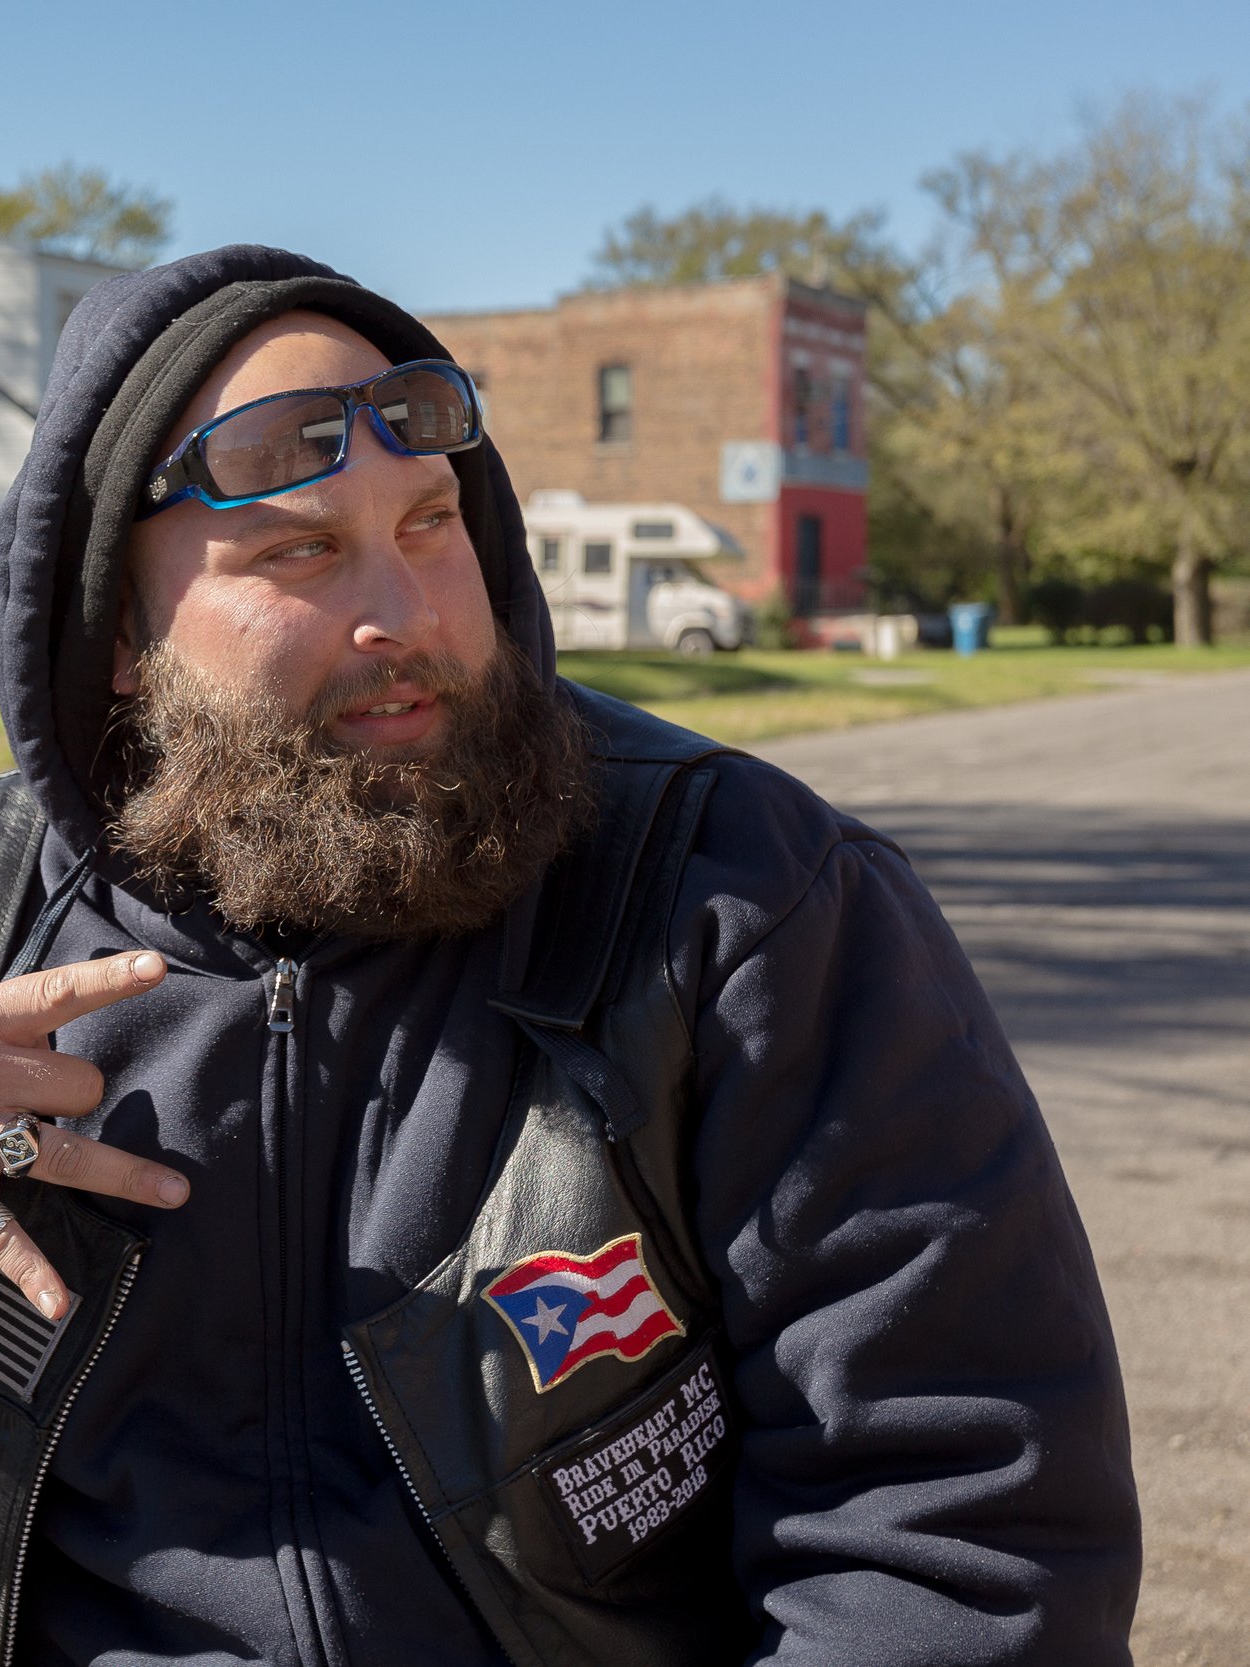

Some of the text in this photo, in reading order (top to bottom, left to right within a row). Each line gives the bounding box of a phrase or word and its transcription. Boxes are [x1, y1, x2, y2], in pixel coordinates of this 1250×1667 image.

[553, 1362, 715, 1496] BRAVEHEART MC
[562, 1390, 721, 1519] RIDE IN PARADISE
[578, 1415, 725, 1545] PUERTO RICO
[627, 1465, 708, 1543] 1983-2018
